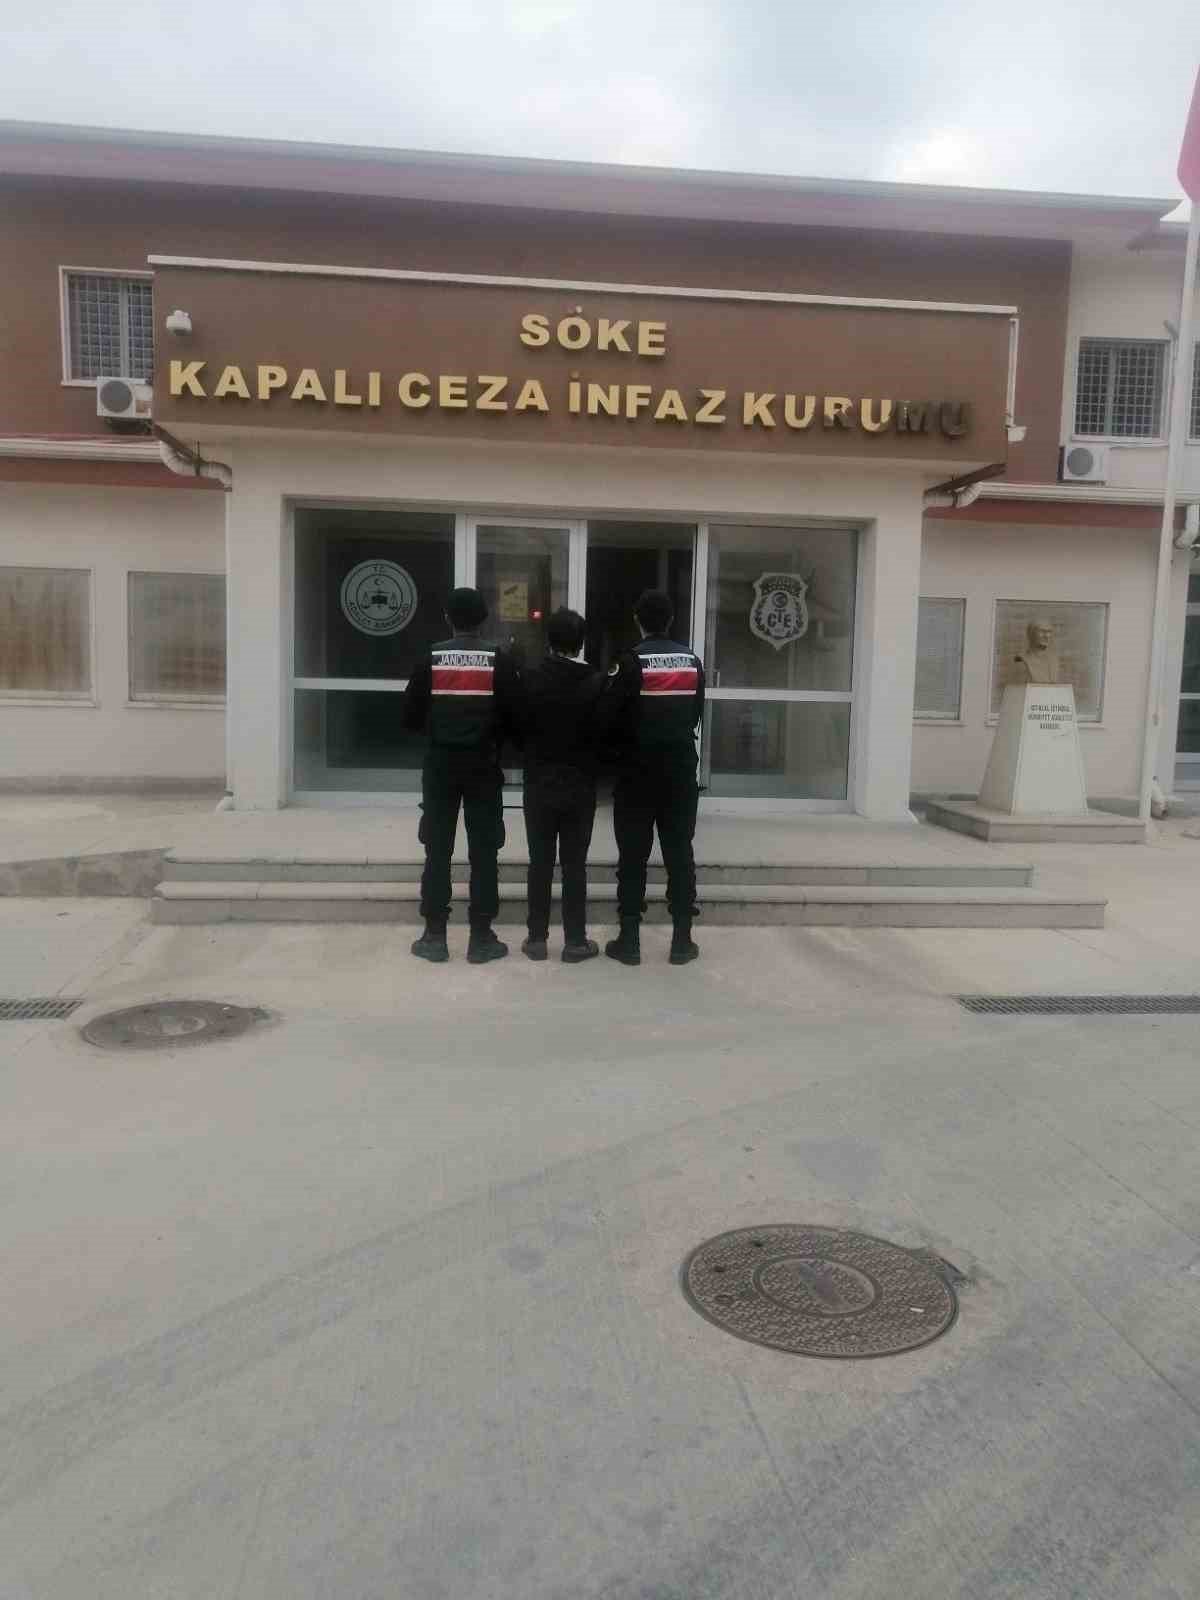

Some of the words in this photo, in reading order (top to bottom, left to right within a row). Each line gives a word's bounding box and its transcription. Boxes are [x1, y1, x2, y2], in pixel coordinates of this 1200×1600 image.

[169, 359, 381, 406] KAPALI
[398, 372, 549, 411] CEZA
[568, 371, 726, 423] İNFAZ
[743, 391, 970, 437] KURUMU
[438, 655, 488, 666] JANDARMA
